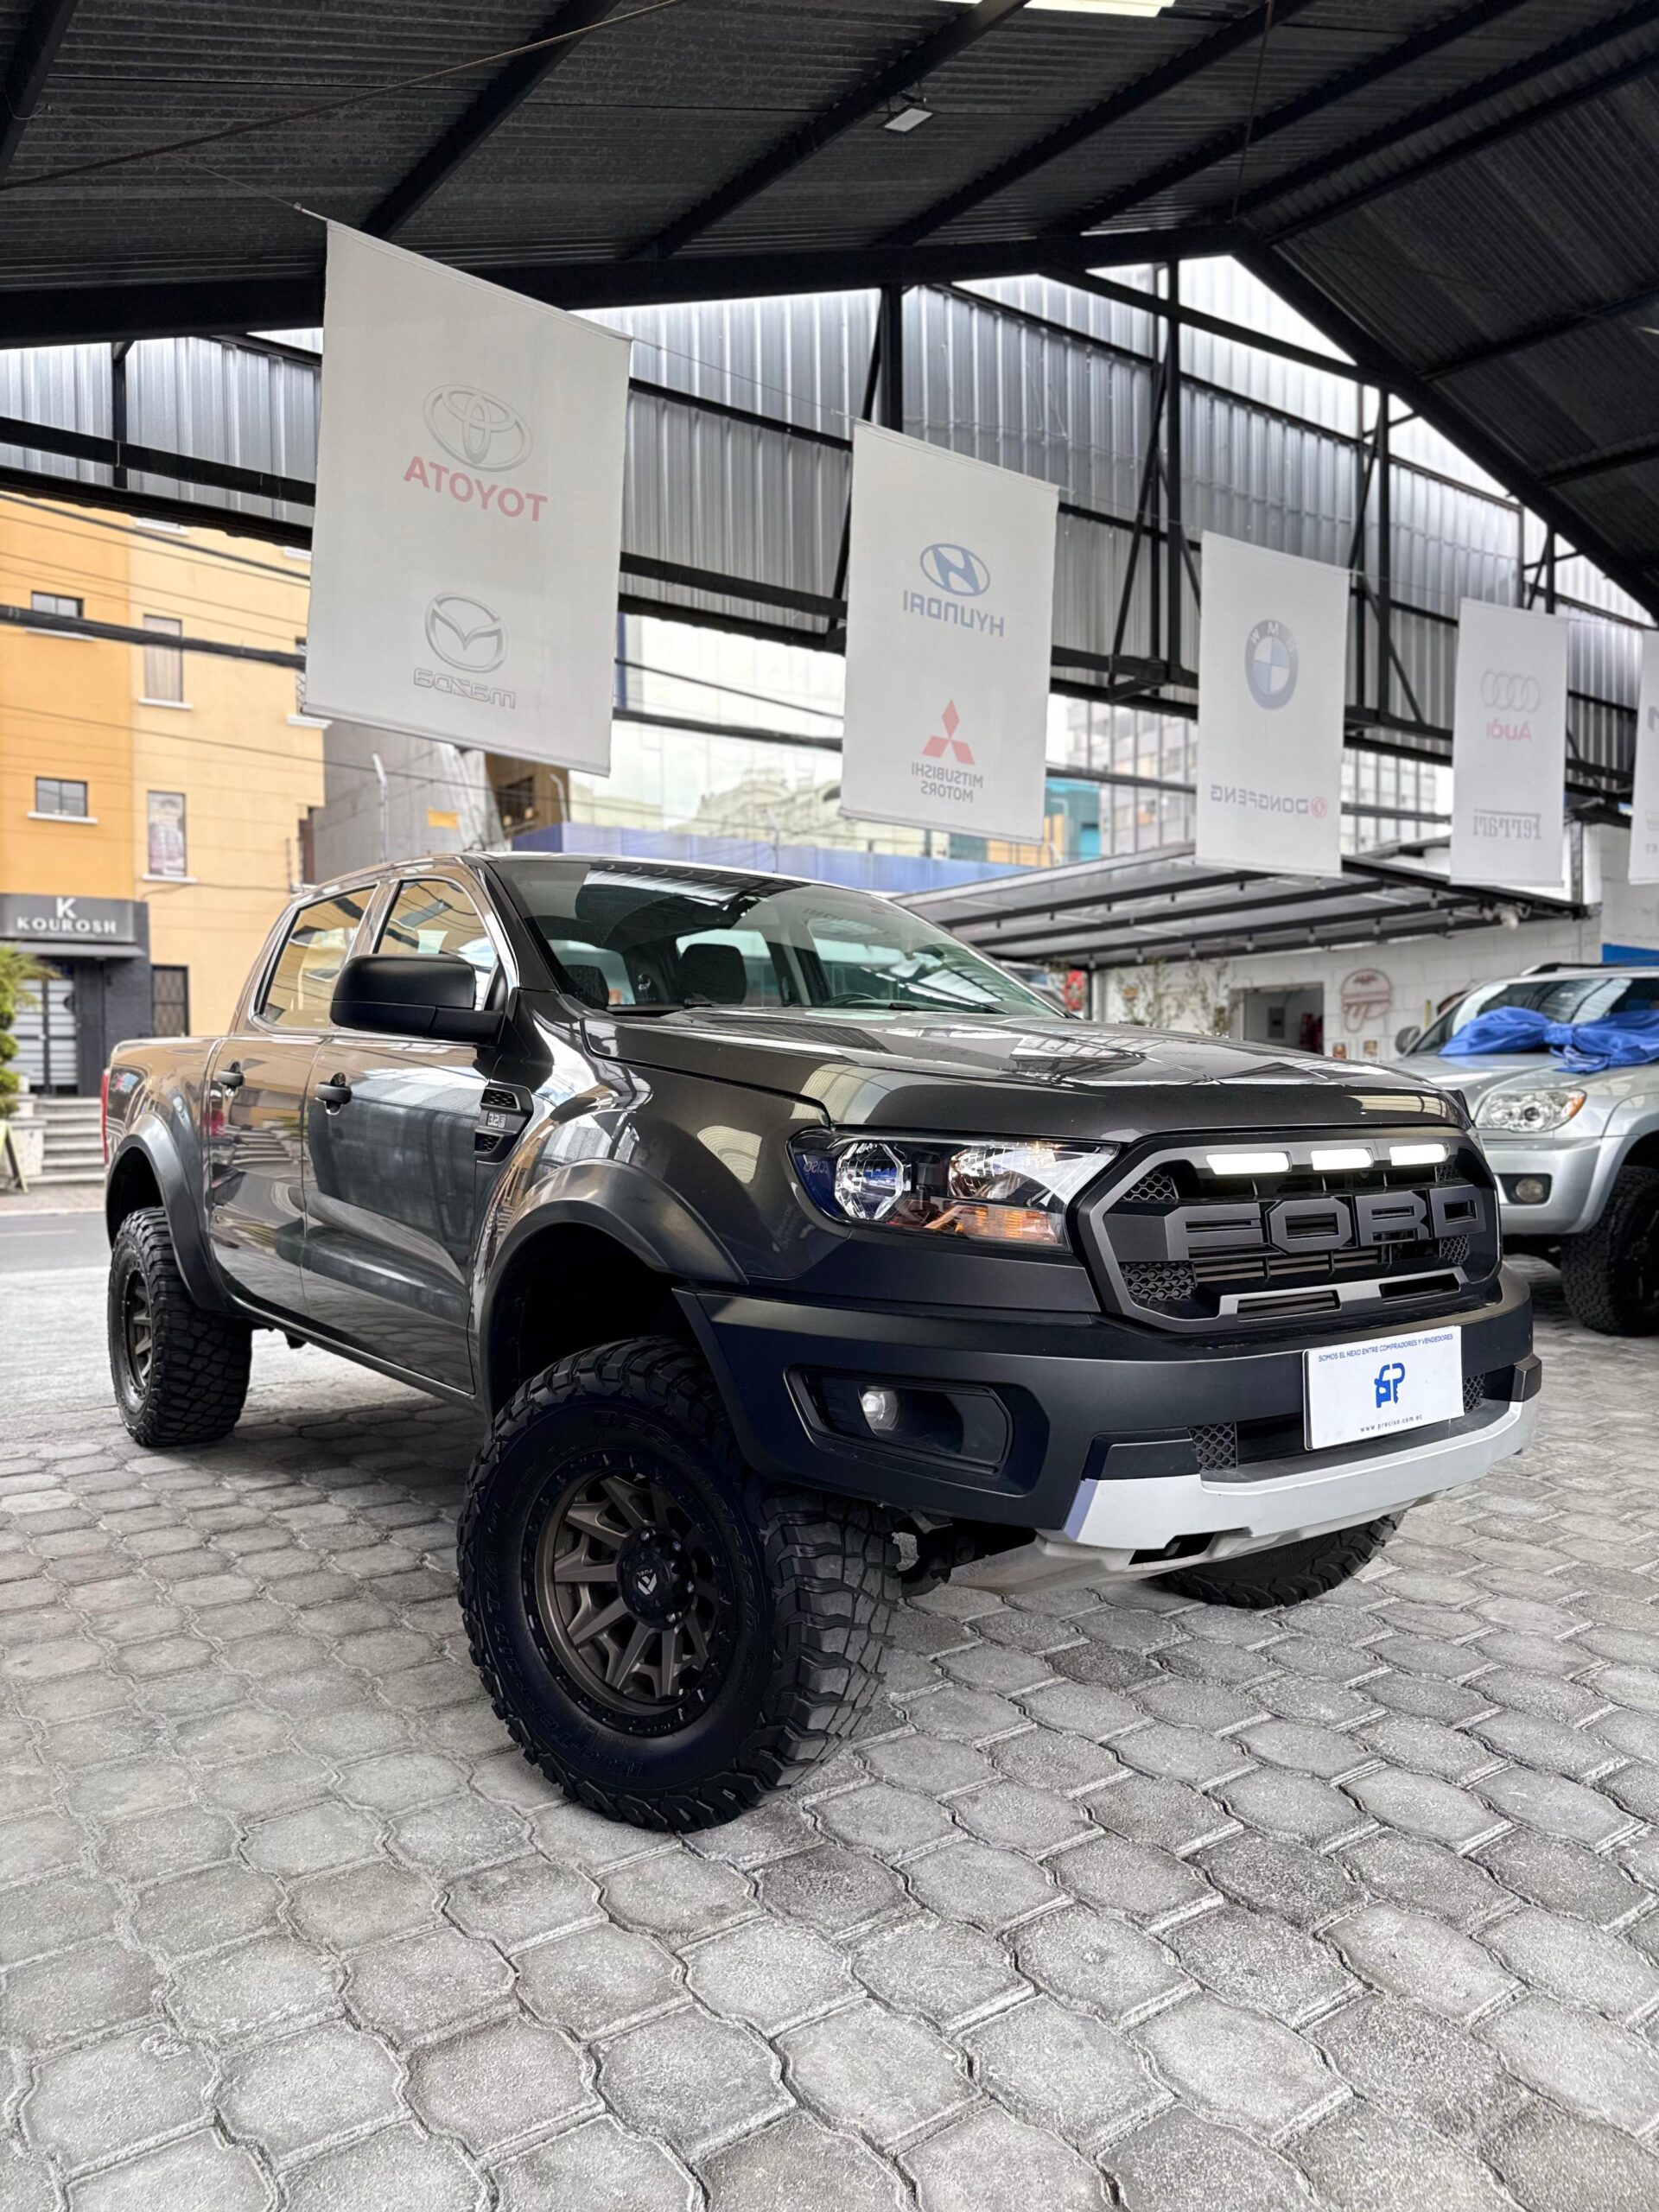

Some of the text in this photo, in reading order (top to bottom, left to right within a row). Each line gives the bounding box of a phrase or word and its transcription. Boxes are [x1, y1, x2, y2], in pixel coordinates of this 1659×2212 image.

[56, 897, 77, 918] K
[17, 917, 117, 933] KOUROSH
[1165, 1185, 1486, 1260] FORD
[1319, 1352, 1338, 1363] SOMOS
[1347, 1348, 1362, 1357] NEXO
[1362, 1345, 1379, 1355] ENTRE
[1380, 1338, 1418, 1351] COMPRADORES
[1422, 1333, 1453, 1344] VENDEDORES
